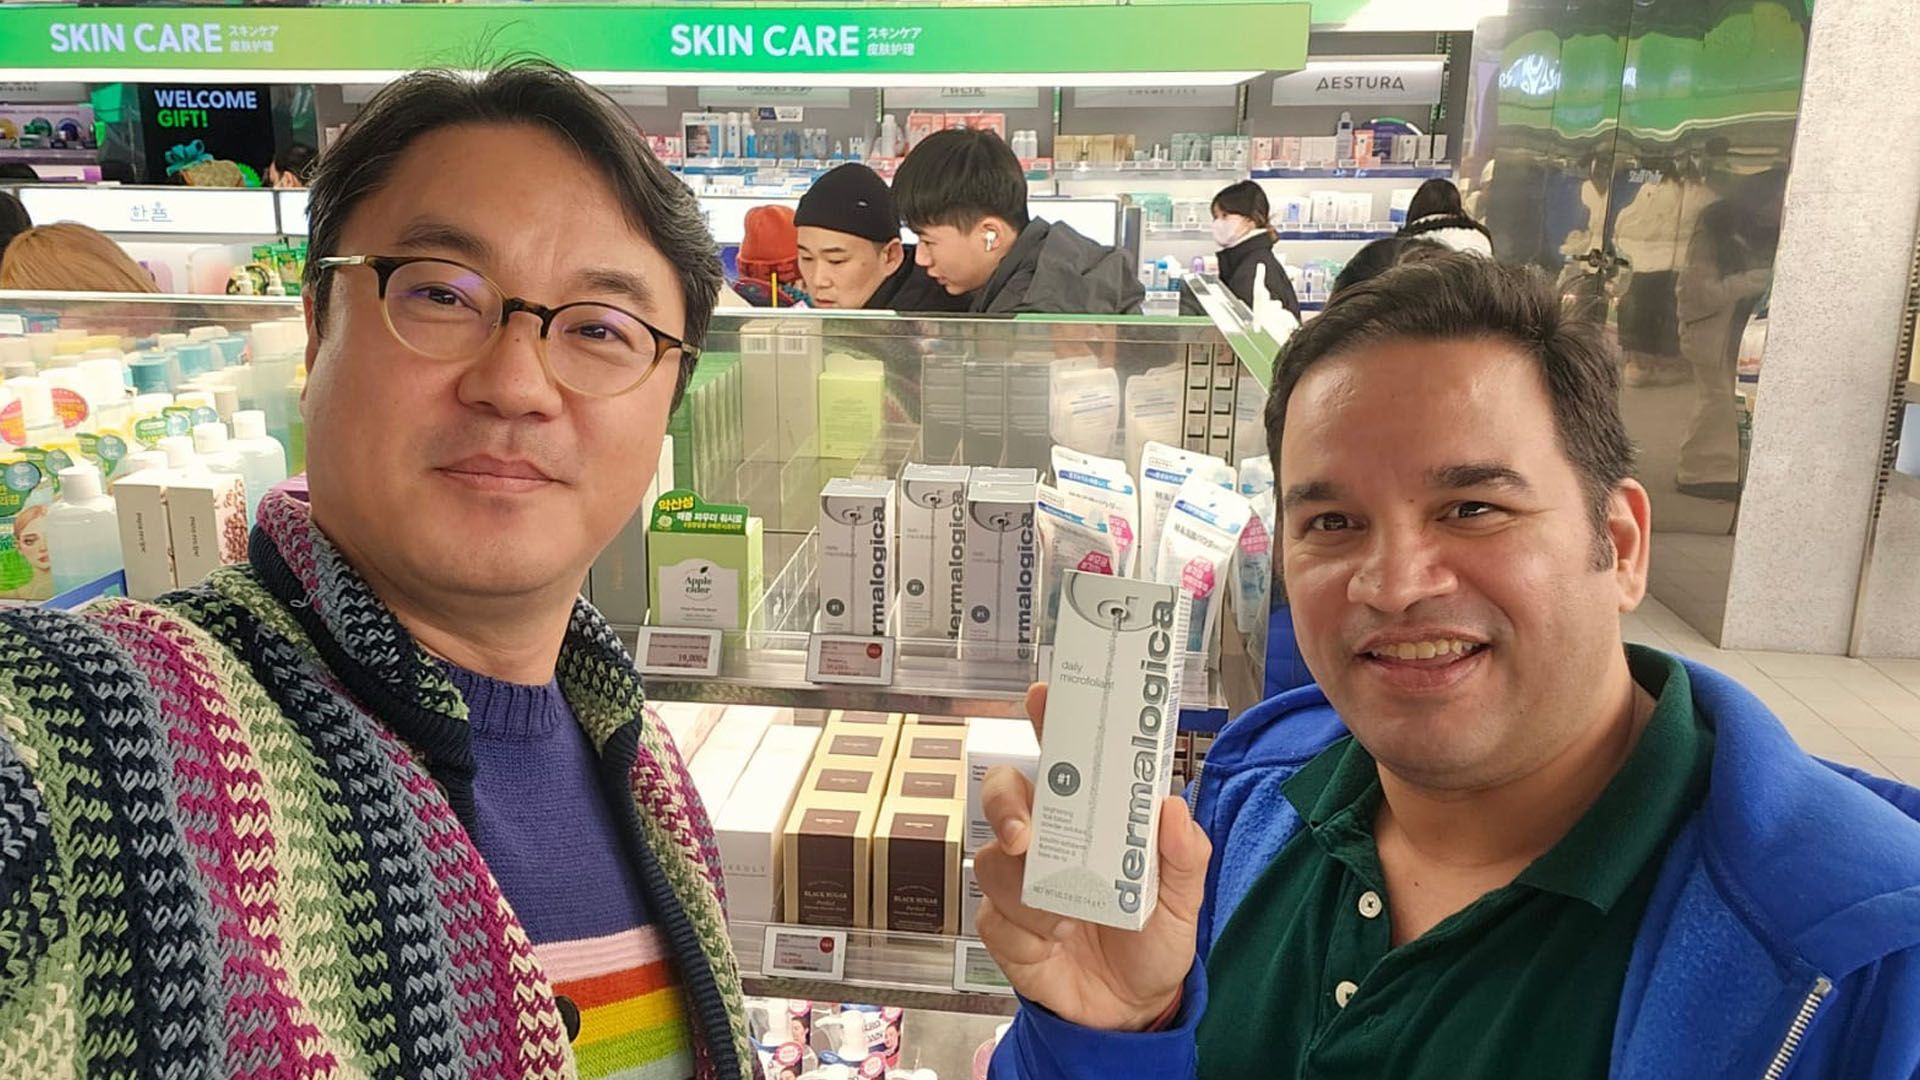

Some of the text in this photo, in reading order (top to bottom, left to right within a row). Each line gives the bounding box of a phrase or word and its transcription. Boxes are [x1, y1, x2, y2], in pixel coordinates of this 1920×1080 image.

[50, 22, 223, 53] SKIN CARE
[670, 24, 860, 56] SKIN CARE
[867, 27, 922, 40] スキンケア
[1316, 76, 1405, 92] AESTURA
[154, 90, 258, 109] WELCOME
[157, 110, 208, 128] GIFT!
[685, 575, 712, 589] Apple
[685, 584, 711, 595] cider
[1061, 660, 1083, 673] daily
[1114, 600, 1176, 914] dermalogica
[1056, 773, 1071, 786] #1
[803, 890, 847, 899] BLACK SUGAR
[893, 895, 938, 905] BLACK SUGAR
